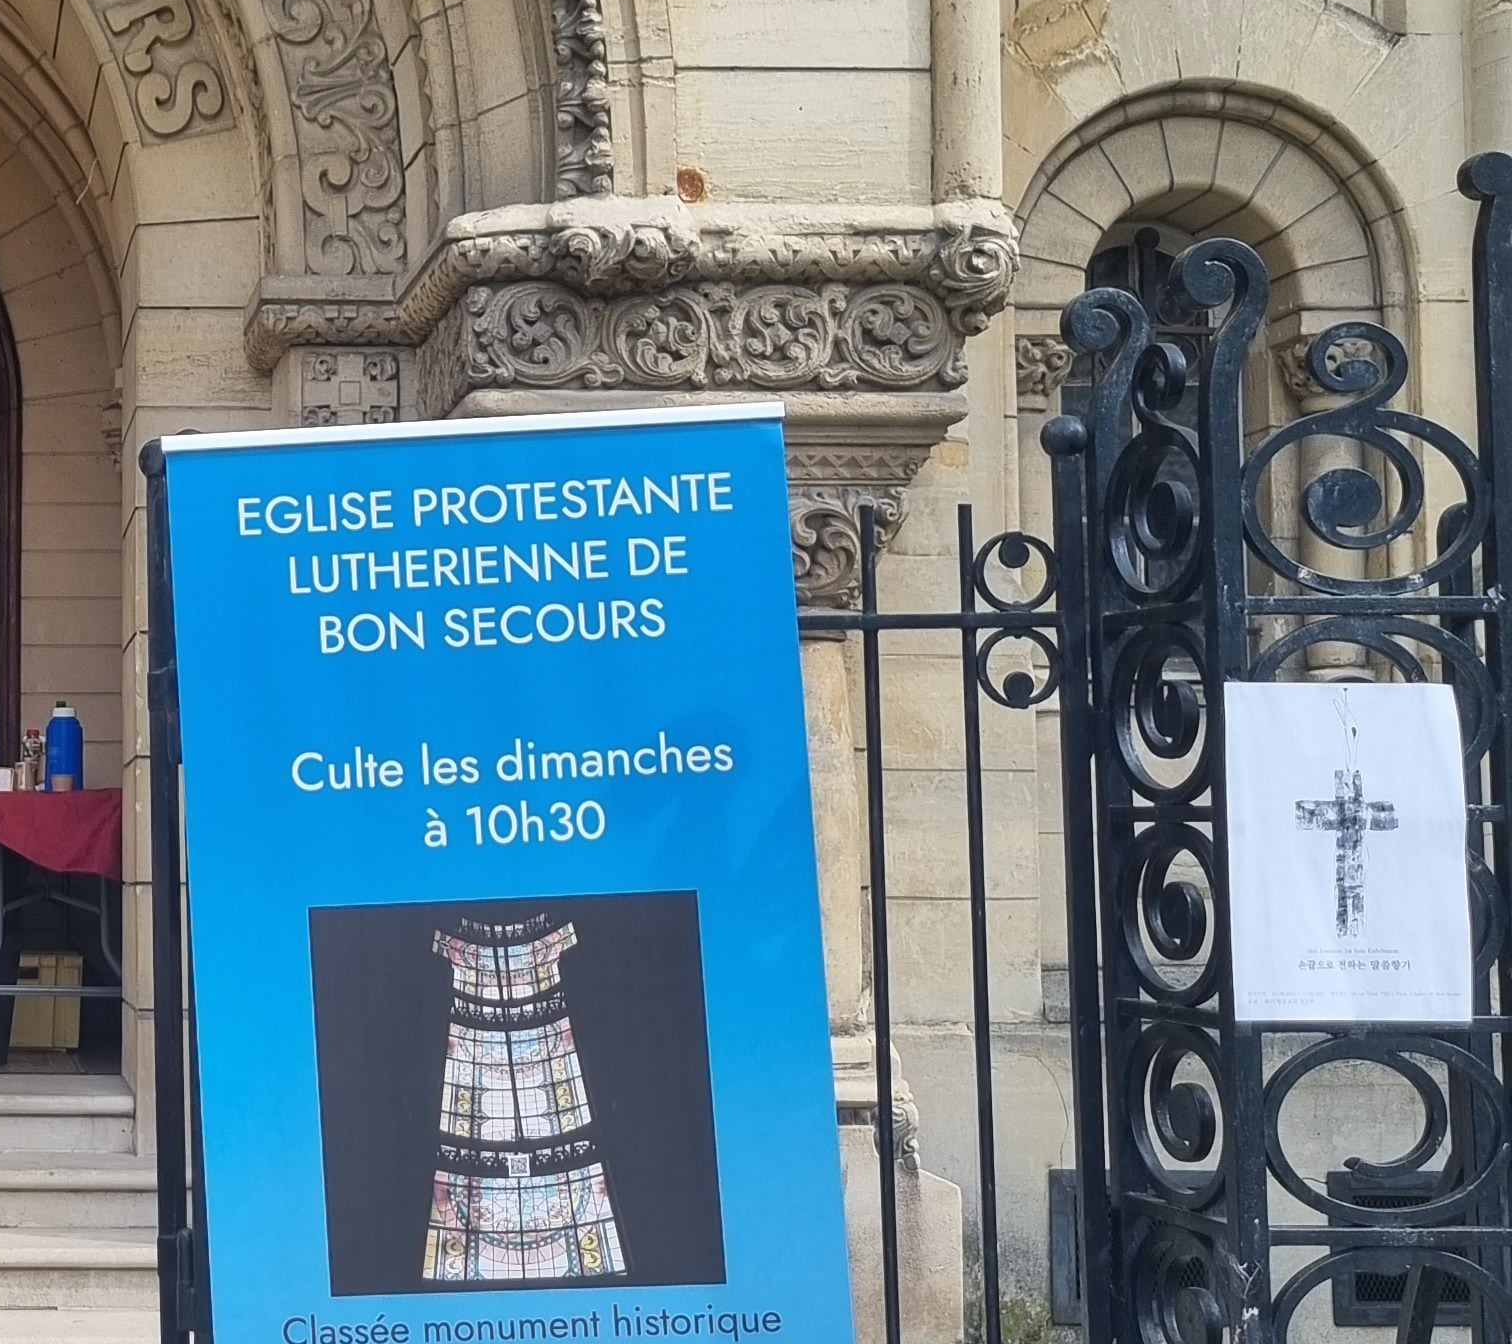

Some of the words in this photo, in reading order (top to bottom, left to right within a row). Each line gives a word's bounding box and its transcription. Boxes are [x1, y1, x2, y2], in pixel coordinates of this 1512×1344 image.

[239, 491, 393, 535] EGLISE
[414, 473, 732, 526] PROTESTANTE
[290, 541, 608, 593] LUTHERIENNE
[629, 536, 687, 575] DE
[320, 611, 424, 653] BON
[444, 599, 665, 647] SECOURS
[292, 747, 403, 790] Culte
[422, 743, 479, 785] les
[497, 732, 732, 781] dimanches
[425, 808, 446, 847] à
[467, 801, 605, 844] 10h30
[425, 1311, 599, 1342] monument
[614, 1304, 781, 1342] historique
